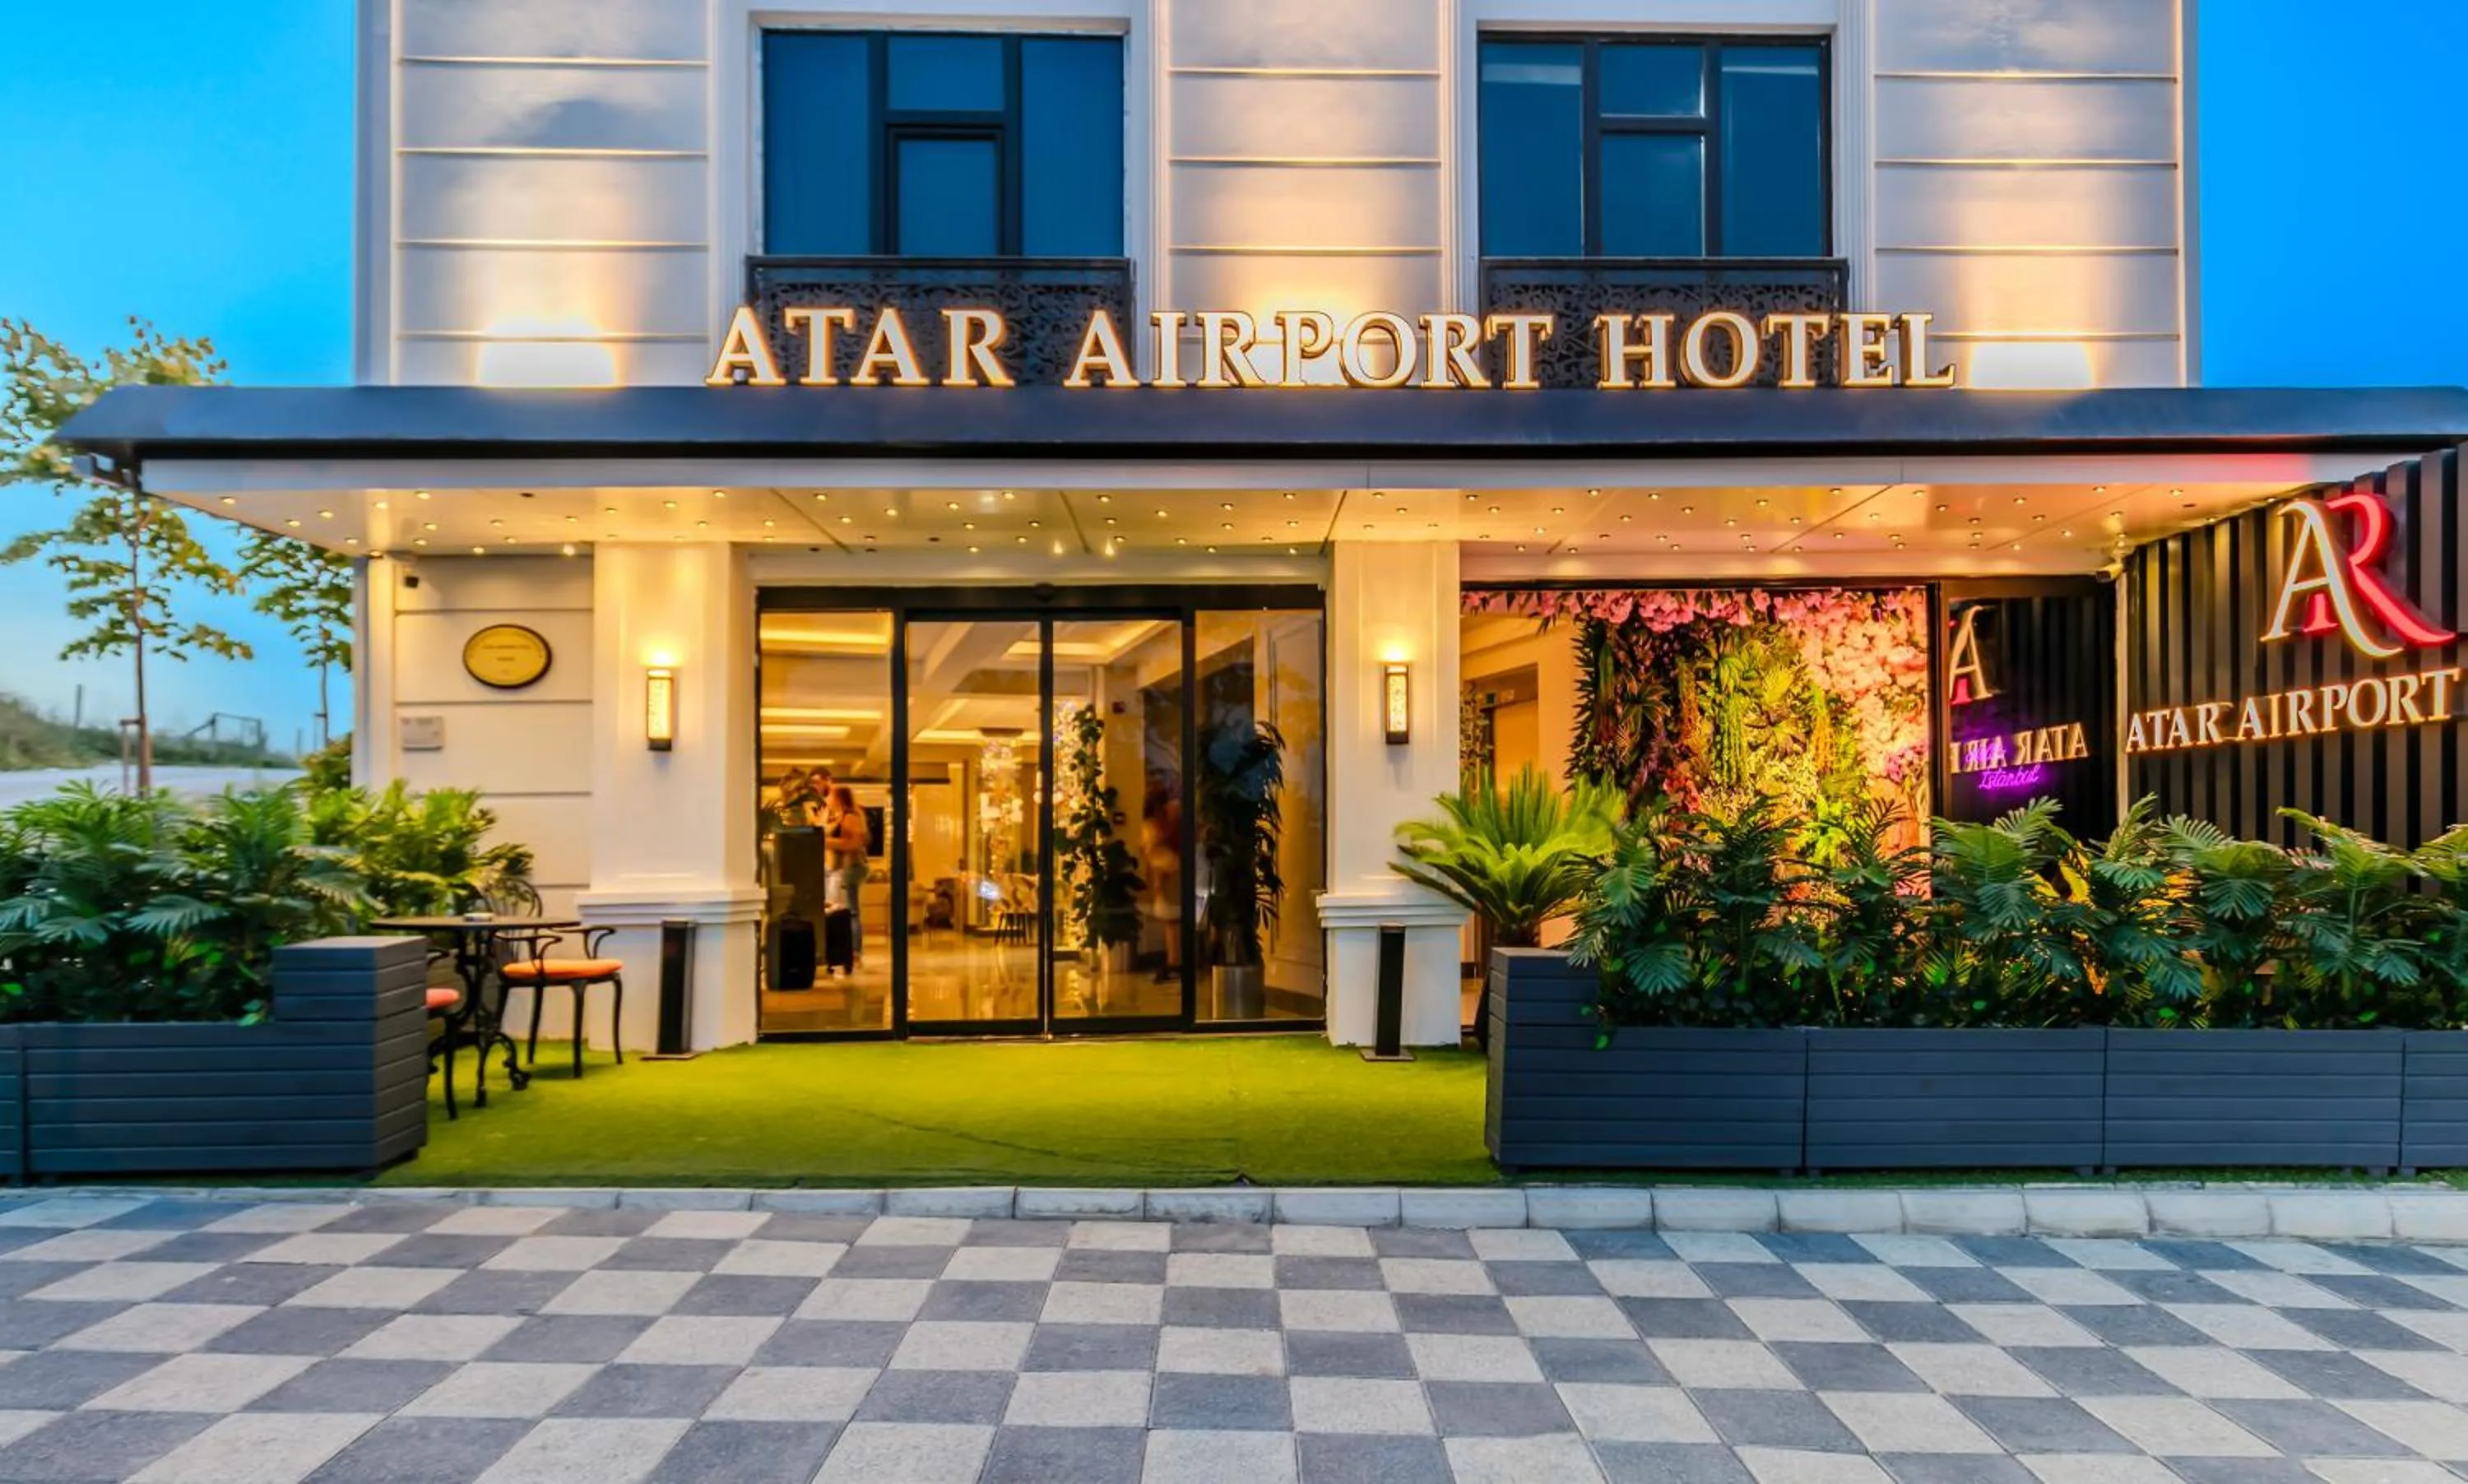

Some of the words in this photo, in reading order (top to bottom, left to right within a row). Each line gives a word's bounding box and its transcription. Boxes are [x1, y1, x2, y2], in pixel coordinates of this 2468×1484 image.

[705, 307, 1016, 388] ATAR
[1063, 309, 1553, 390] AIRPORT
[1593, 311, 1956, 390] HOTEL
[2259, 494, 2456, 657] AR
[2124, 701, 2234, 754] ATAR
[2235, 667, 2461, 742] AIRPORT
